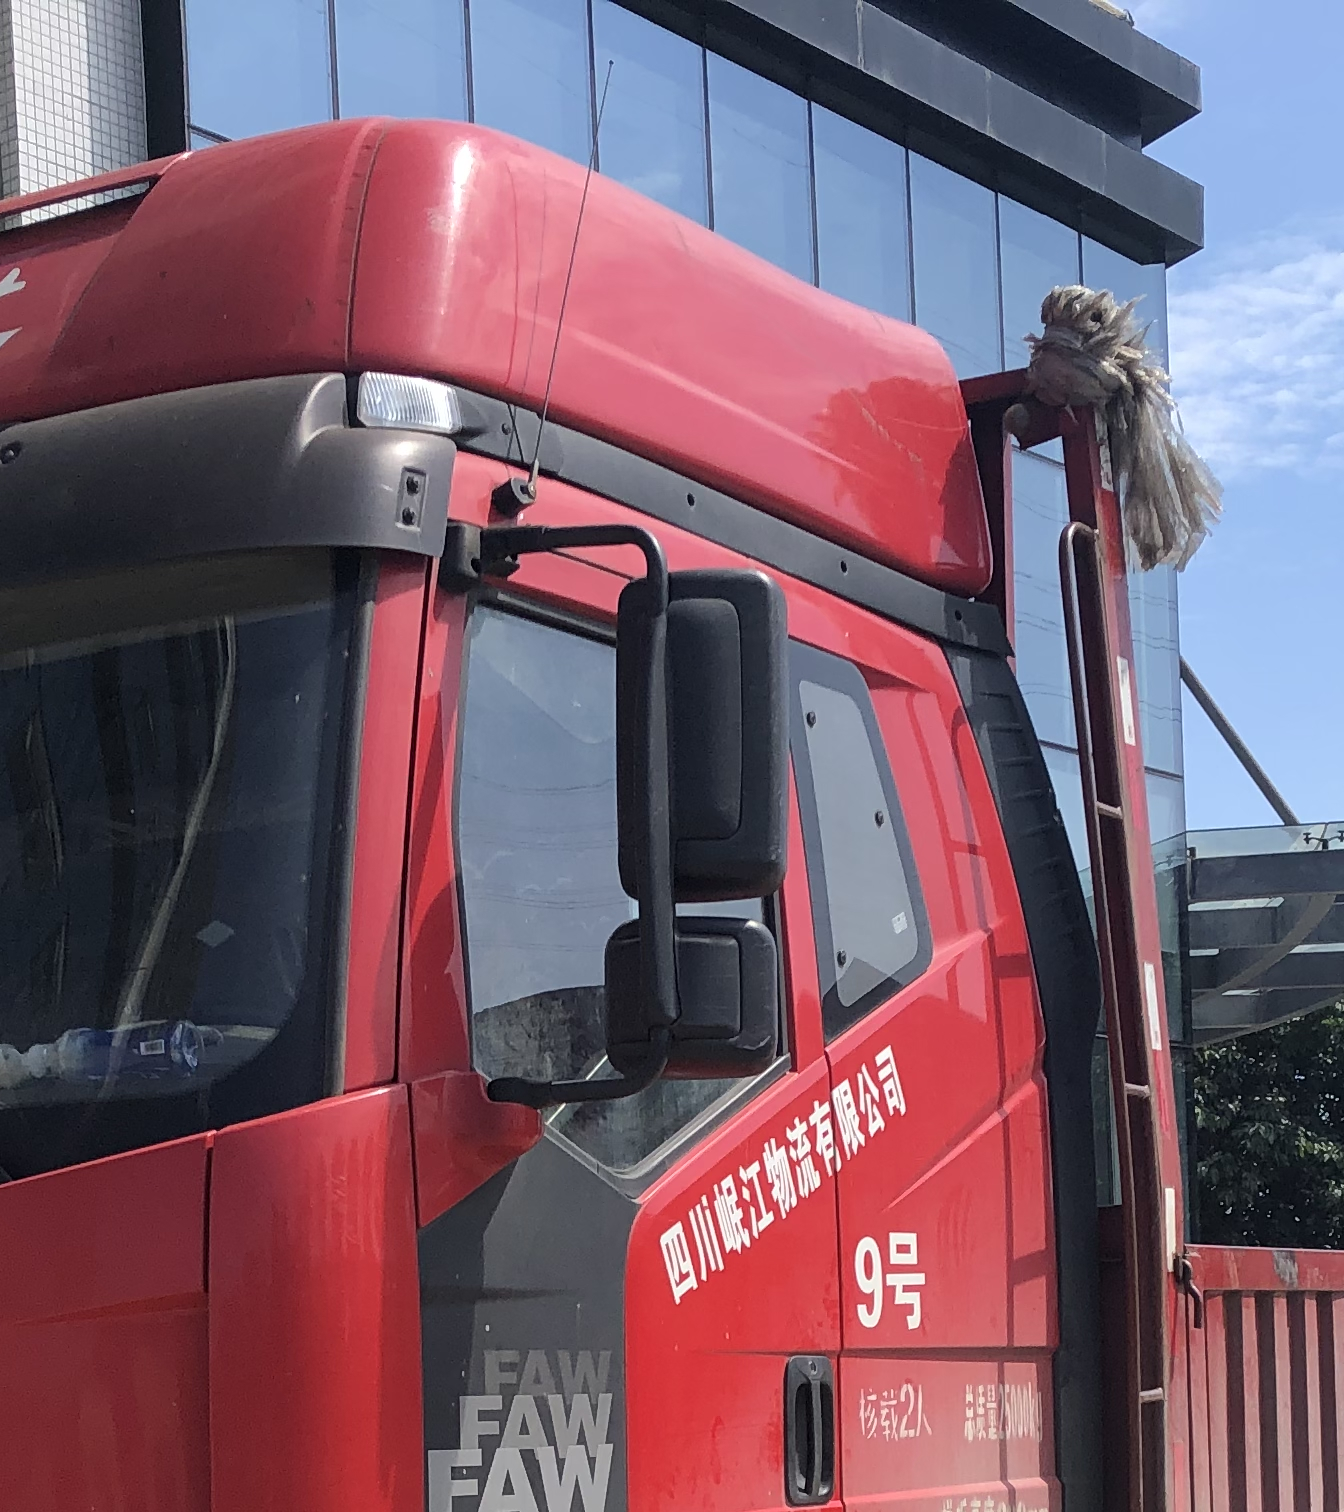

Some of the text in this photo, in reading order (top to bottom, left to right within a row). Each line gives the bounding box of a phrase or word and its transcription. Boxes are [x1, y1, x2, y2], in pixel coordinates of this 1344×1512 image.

[659, 1044, 907, 1305] 四川岷江物流有限公司
[854, 1231, 926, 1330] 9号
[482, 1349, 612, 1404] FAW
[459, 1392, 613, 1460] FAW
[859, 1383, 932, 1441] 核载2人
